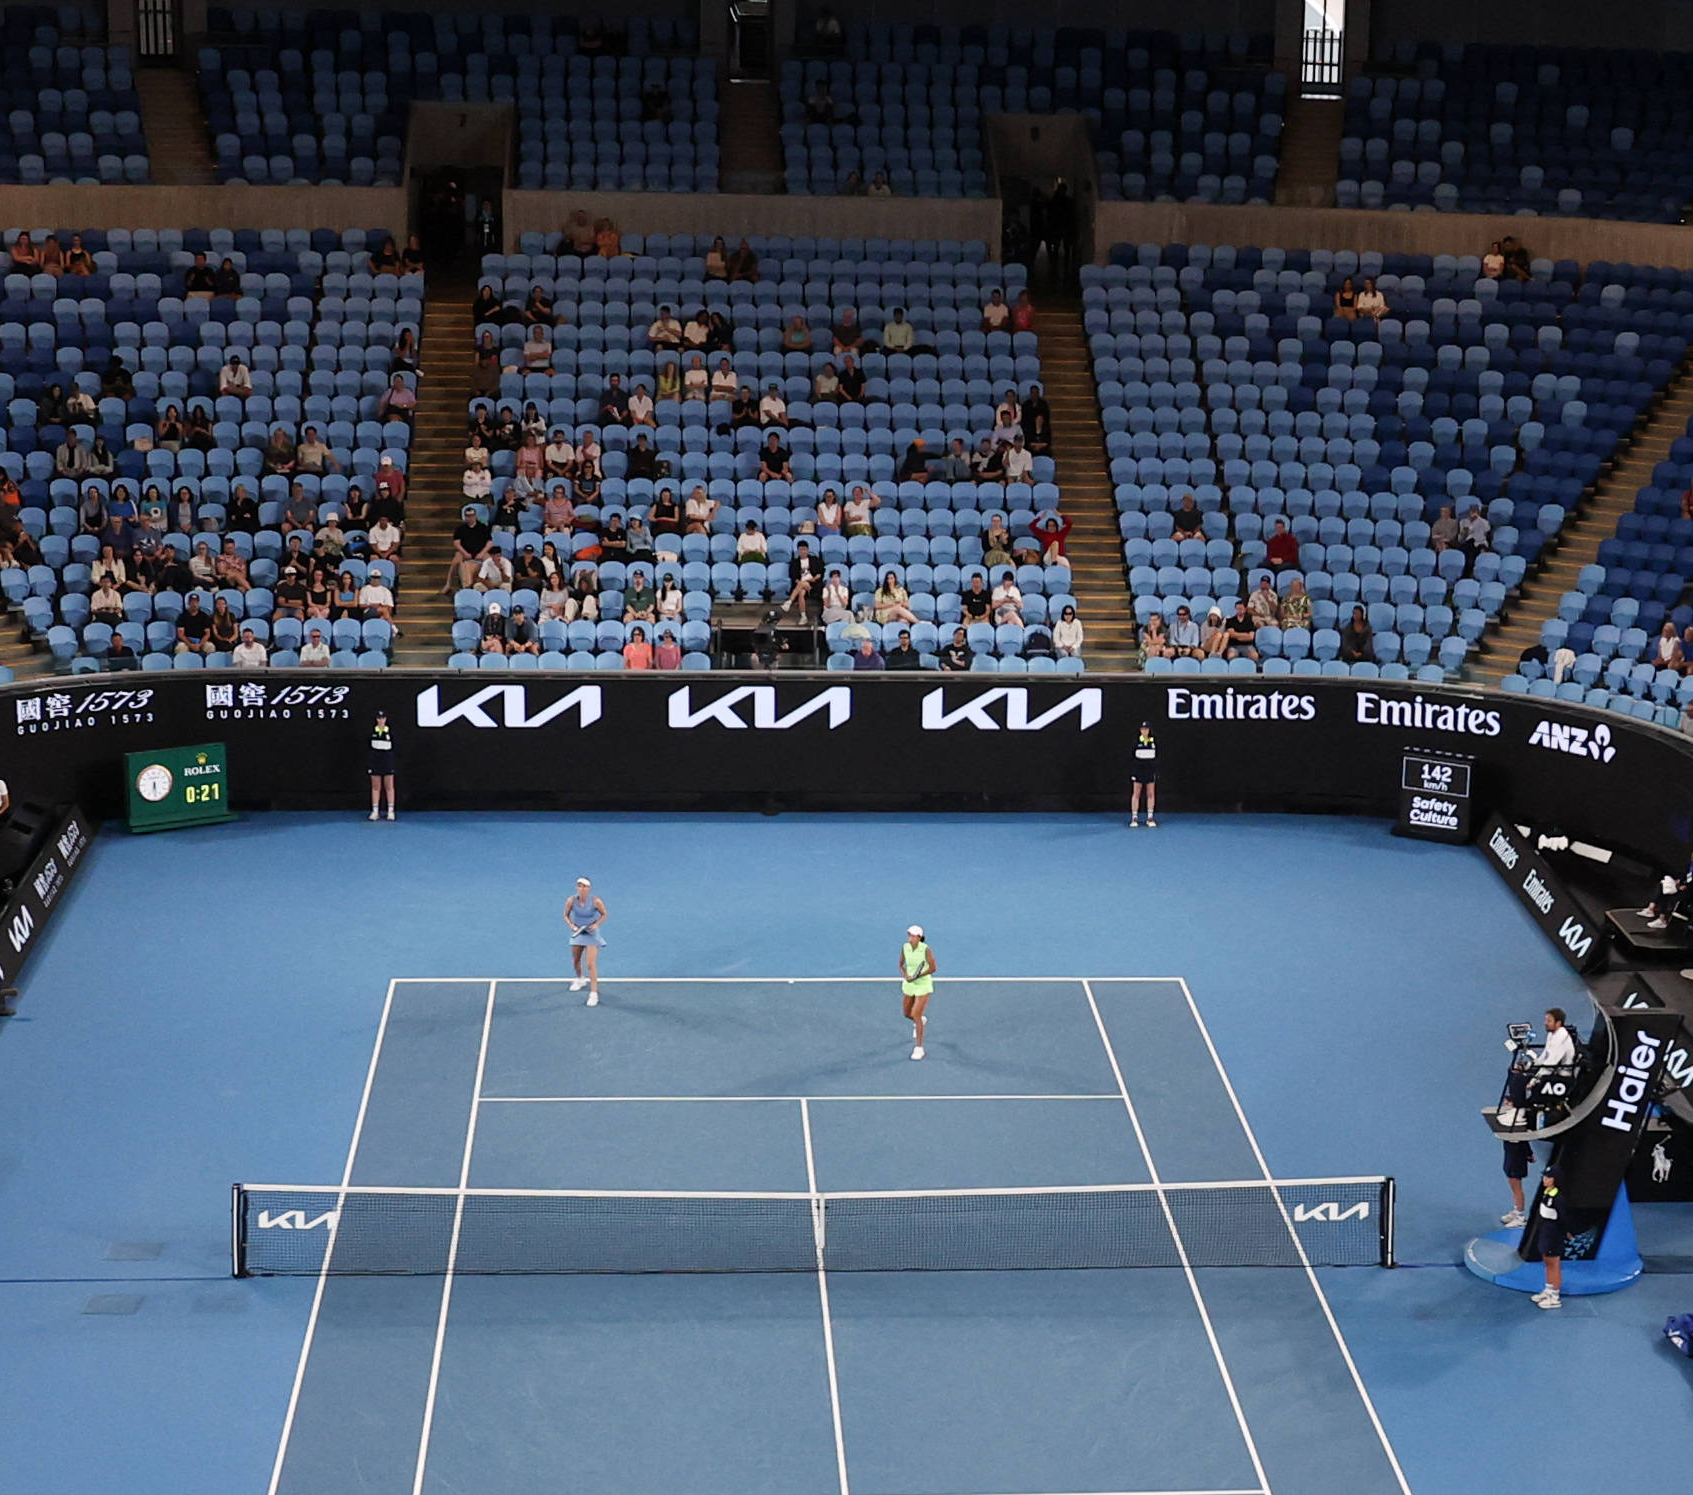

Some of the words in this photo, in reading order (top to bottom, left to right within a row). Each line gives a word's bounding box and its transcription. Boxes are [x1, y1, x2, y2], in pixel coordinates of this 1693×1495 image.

[206, 709, 291, 720] GUOJIAO
[306, 709, 349, 720] 1573
[1167, 687, 1316, 721] Emirates
[1356, 691, 1501, 736] Emirates
[17, 716, 96, 735] GUOJIAO
[111, 712, 154, 725] 1573
[1528, 721, 1588, 752] ANZ
[184, 765, 220, 776] ROLEX
[1421, 764, 1452, 782] 142
[186, 783, 219, 803] 0:21
[1423, 780, 1448, 791] km/h
[1412, 796, 1457, 815] Safety
[1410, 809, 1458, 826] Culture
[1489, 827, 1519, 870] Emirates
[1522, 868, 1555, 914] Emirates
[1601, 1029, 1661, 1132] Haier
